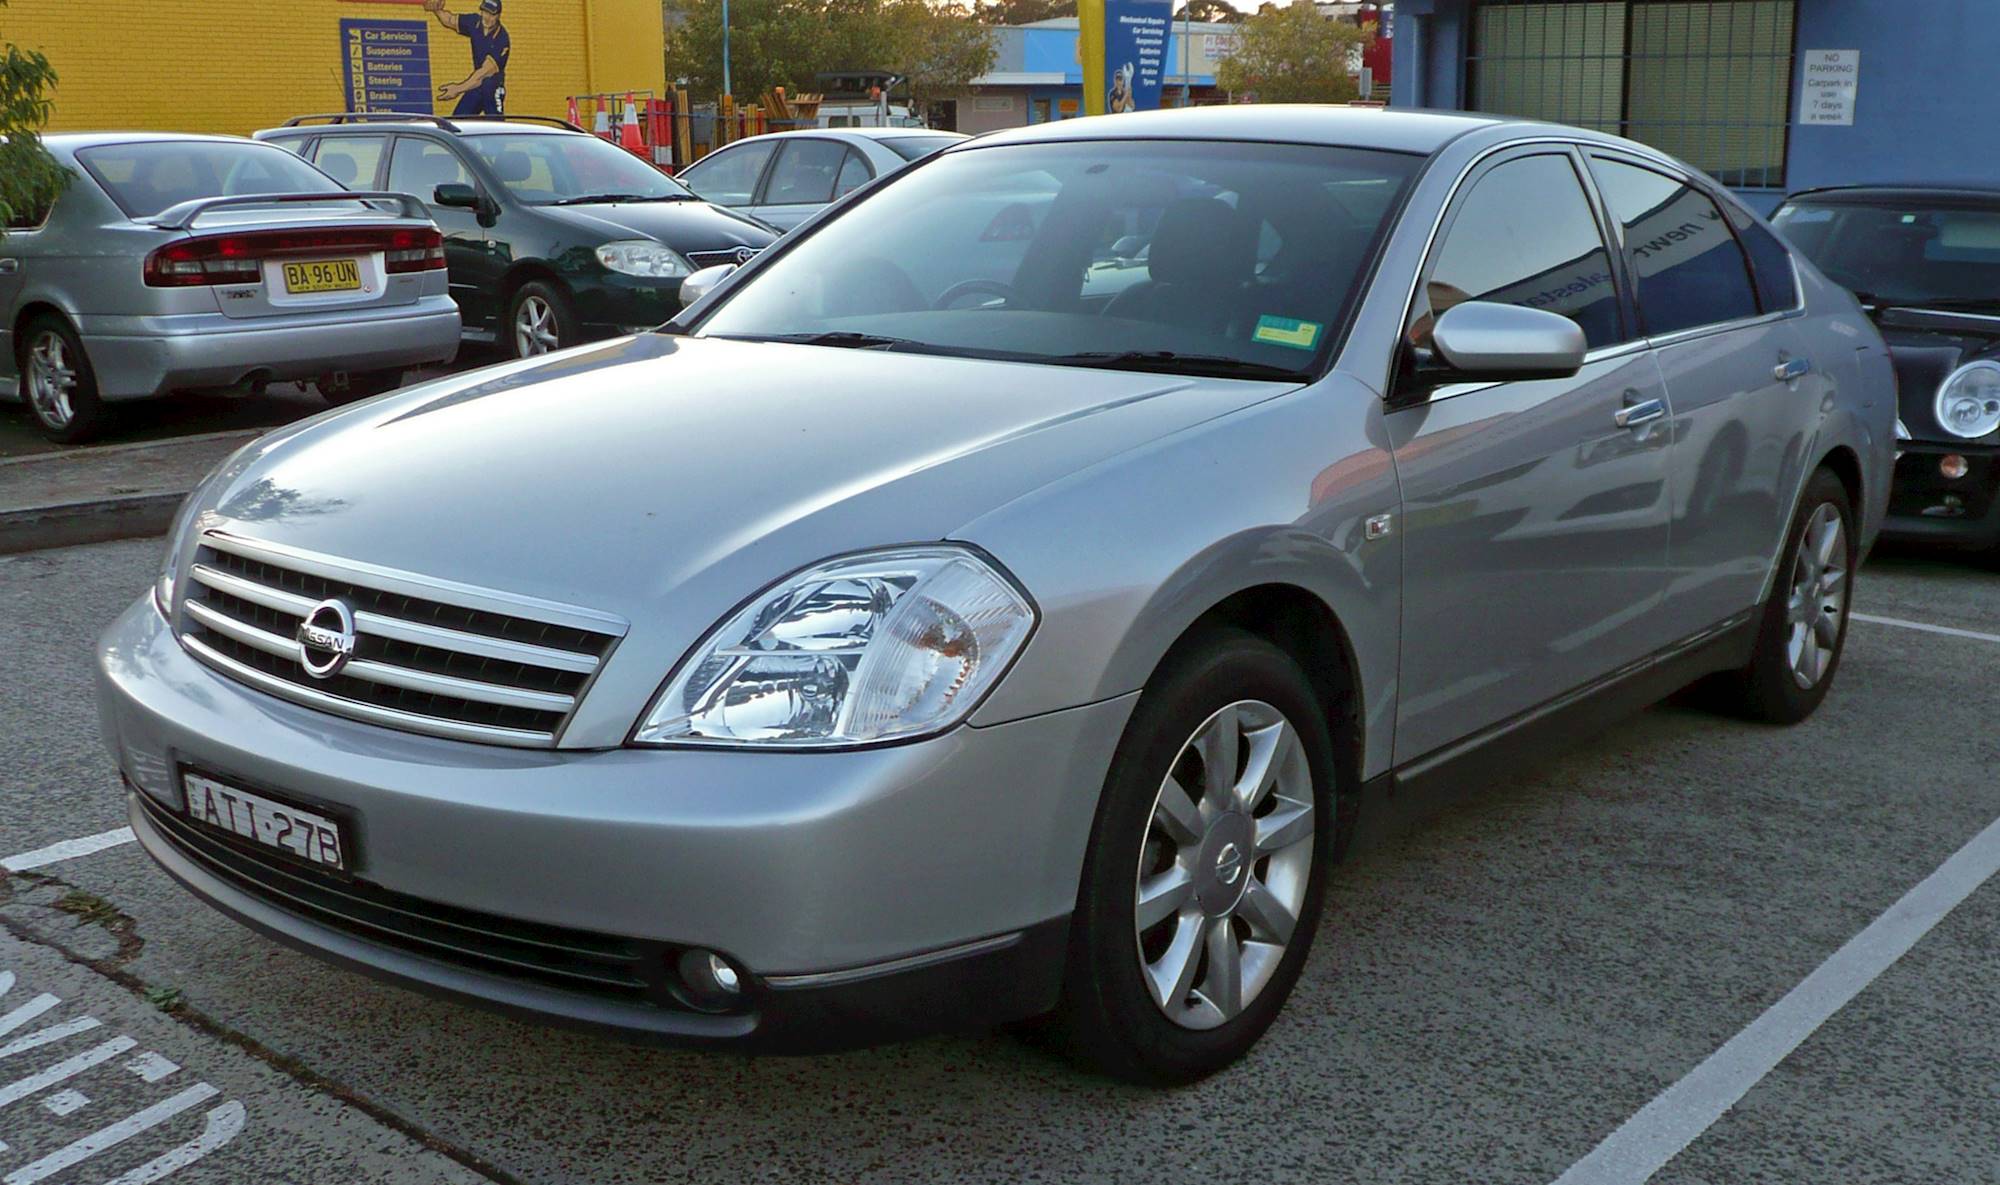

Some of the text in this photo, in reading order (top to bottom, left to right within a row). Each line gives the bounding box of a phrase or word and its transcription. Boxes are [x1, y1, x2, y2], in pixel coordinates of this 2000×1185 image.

[1142, 27, 1164, 36] Servicing
[365, 31, 417, 43] Car Servicing
[366, 46, 412, 56] Suspension
[1824, 53, 1840, 62] NO
[367, 62, 403, 71] Batteries
[1809, 64, 1854, 73] PARKING
[368, 76, 402, 87] Steering
[1843, 79, 1853, 87] in
[369, 91, 397, 100] Brakes
[1813, 100, 1843, 110] 7 days
[303, 627, 345, 650] NISSAN
